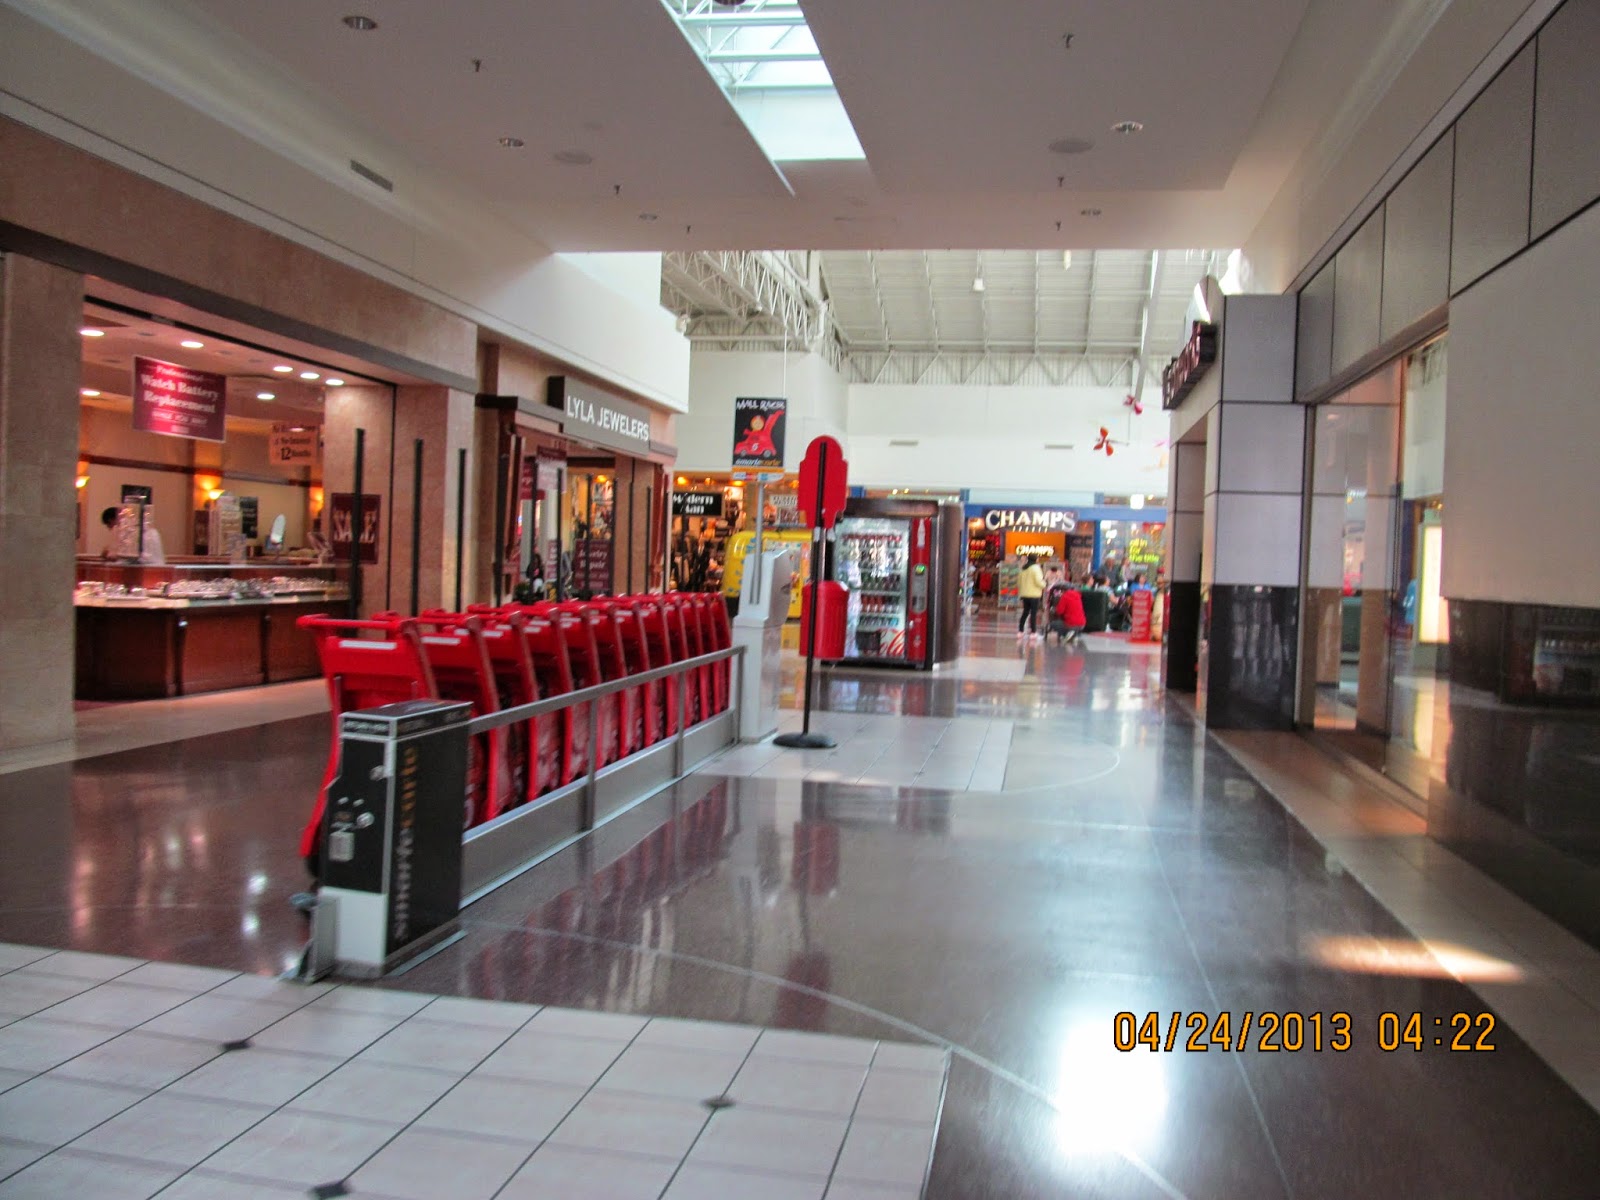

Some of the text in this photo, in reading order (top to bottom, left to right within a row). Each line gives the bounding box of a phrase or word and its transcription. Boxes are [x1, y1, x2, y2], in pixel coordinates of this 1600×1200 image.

[141, 374, 219, 402] Watch Battery
[143, 390, 216, 413] Replacement
[567, 396, 649, 441] LYLA JEWELERS
[281, 447, 291, 460] 12
[672, 493, 713, 504] Mdern
[333, 510, 377, 544] SAE
[985, 510, 1075, 533] CHAMPS
[1015, 545, 1054, 556] CHAMPS
